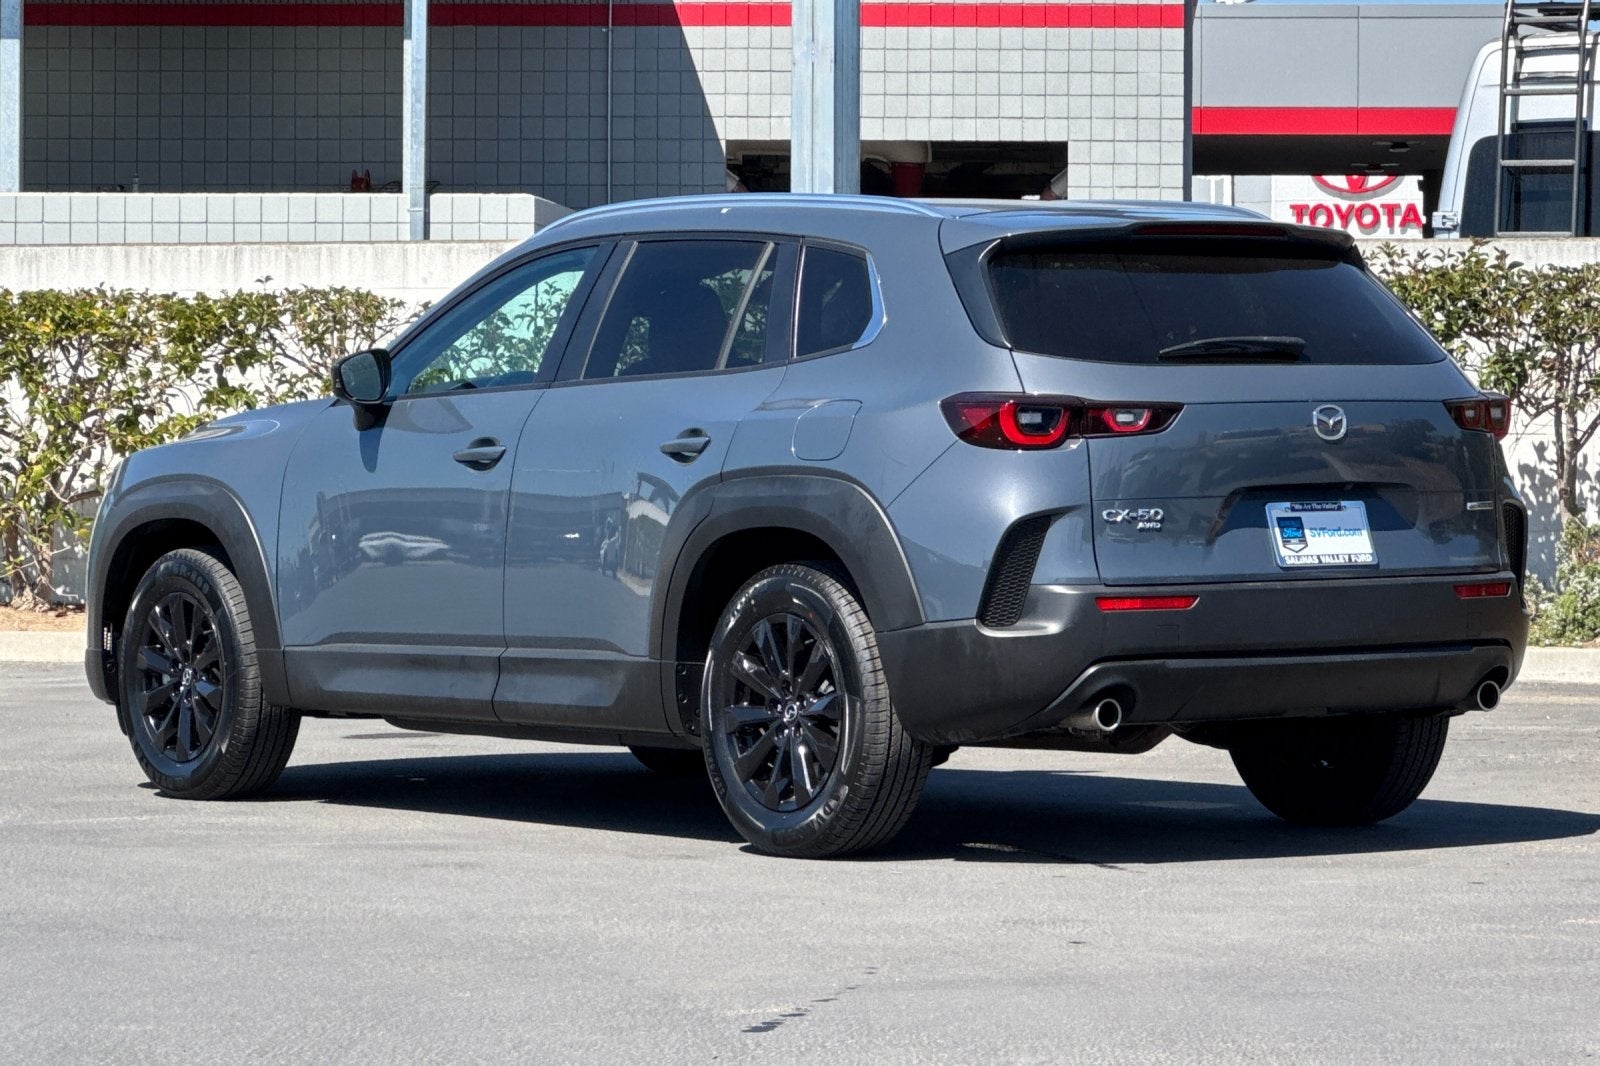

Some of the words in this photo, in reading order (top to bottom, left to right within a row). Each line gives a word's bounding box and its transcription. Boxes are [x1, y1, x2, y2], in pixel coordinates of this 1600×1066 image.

[1289, 202, 1424, 230] TOYOTA
[1102, 508, 1164, 521] CX-50
[1136, 521, 1161, 530] AWD
[1282, 527, 1303, 538] Ford
[1309, 526, 1363, 538] SVFord.com
[1284, 554, 1319, 565] SALINAS
[1319, 553, 1349, 564] VALLEY
[1350, 552, 1373, 563] FORD
